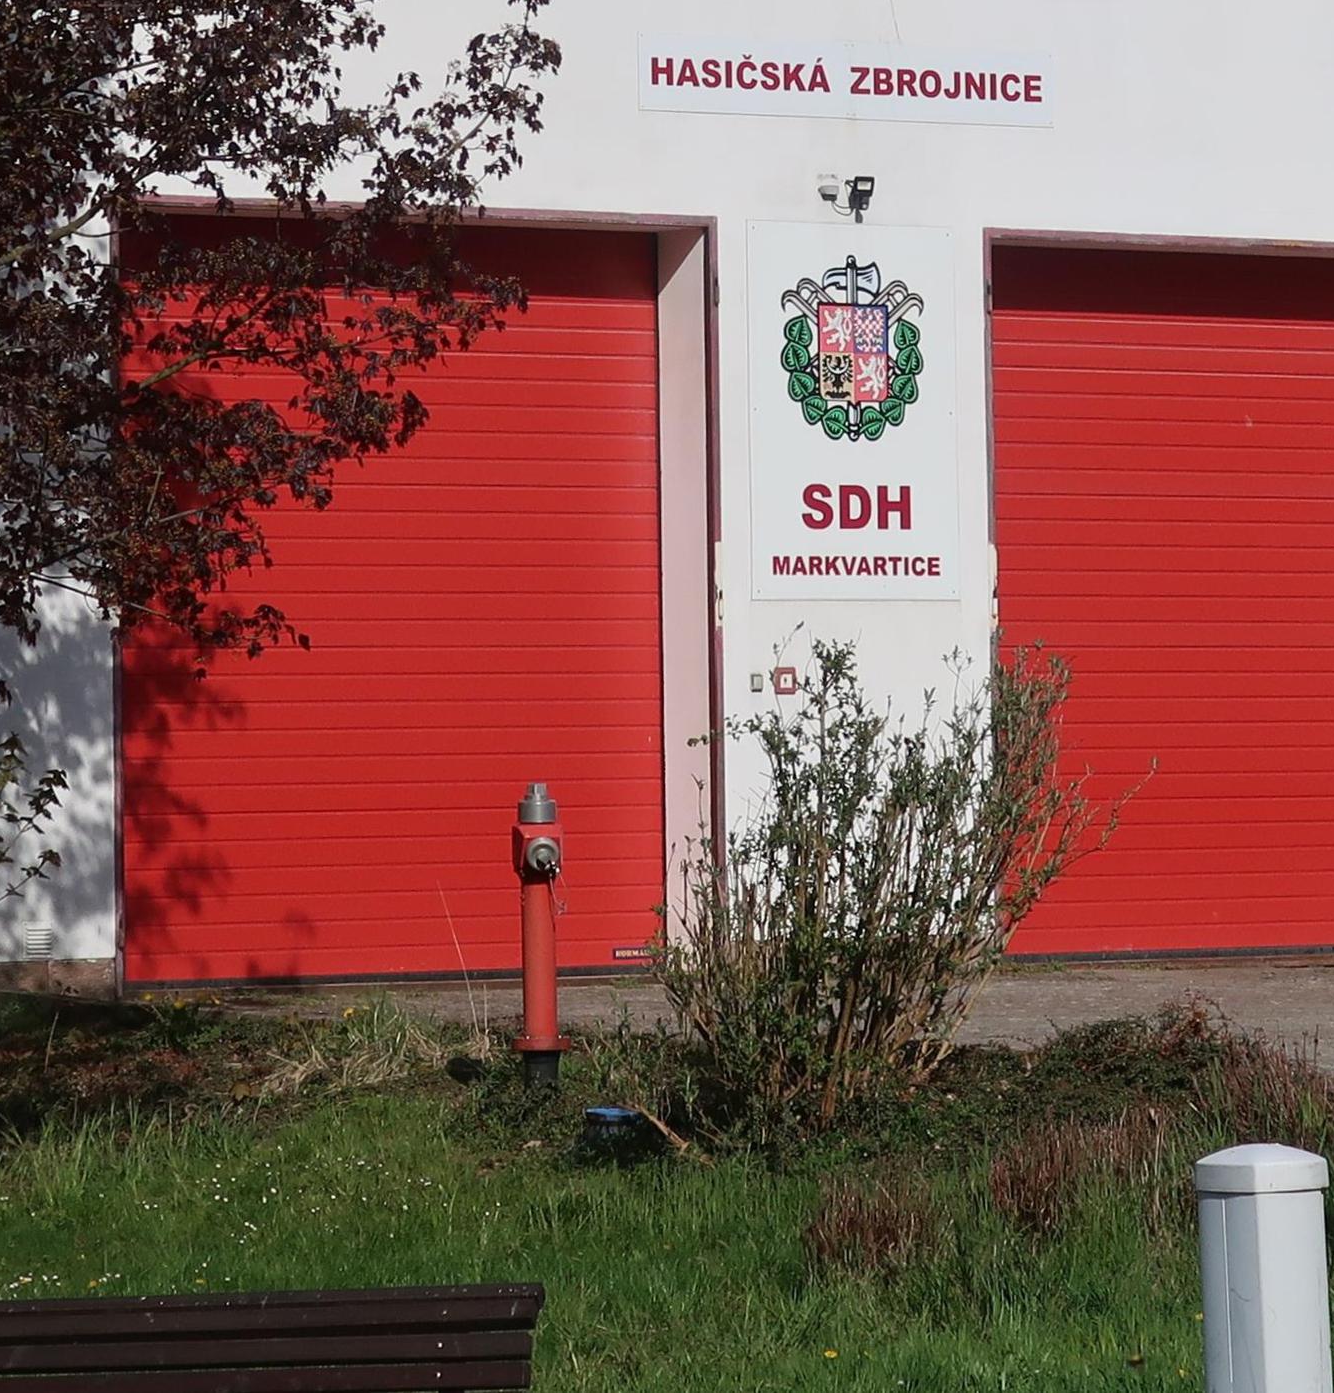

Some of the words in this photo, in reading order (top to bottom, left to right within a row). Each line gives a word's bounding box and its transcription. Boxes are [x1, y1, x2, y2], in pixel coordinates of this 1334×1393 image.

[651, 54, 831, 93] HASIČSKÁ
[850, 66, 1043, 103] ZBROJNICE
[801, 483, 913, 531] SDH
[772, 555, 941, 577] MARKVARTICE
